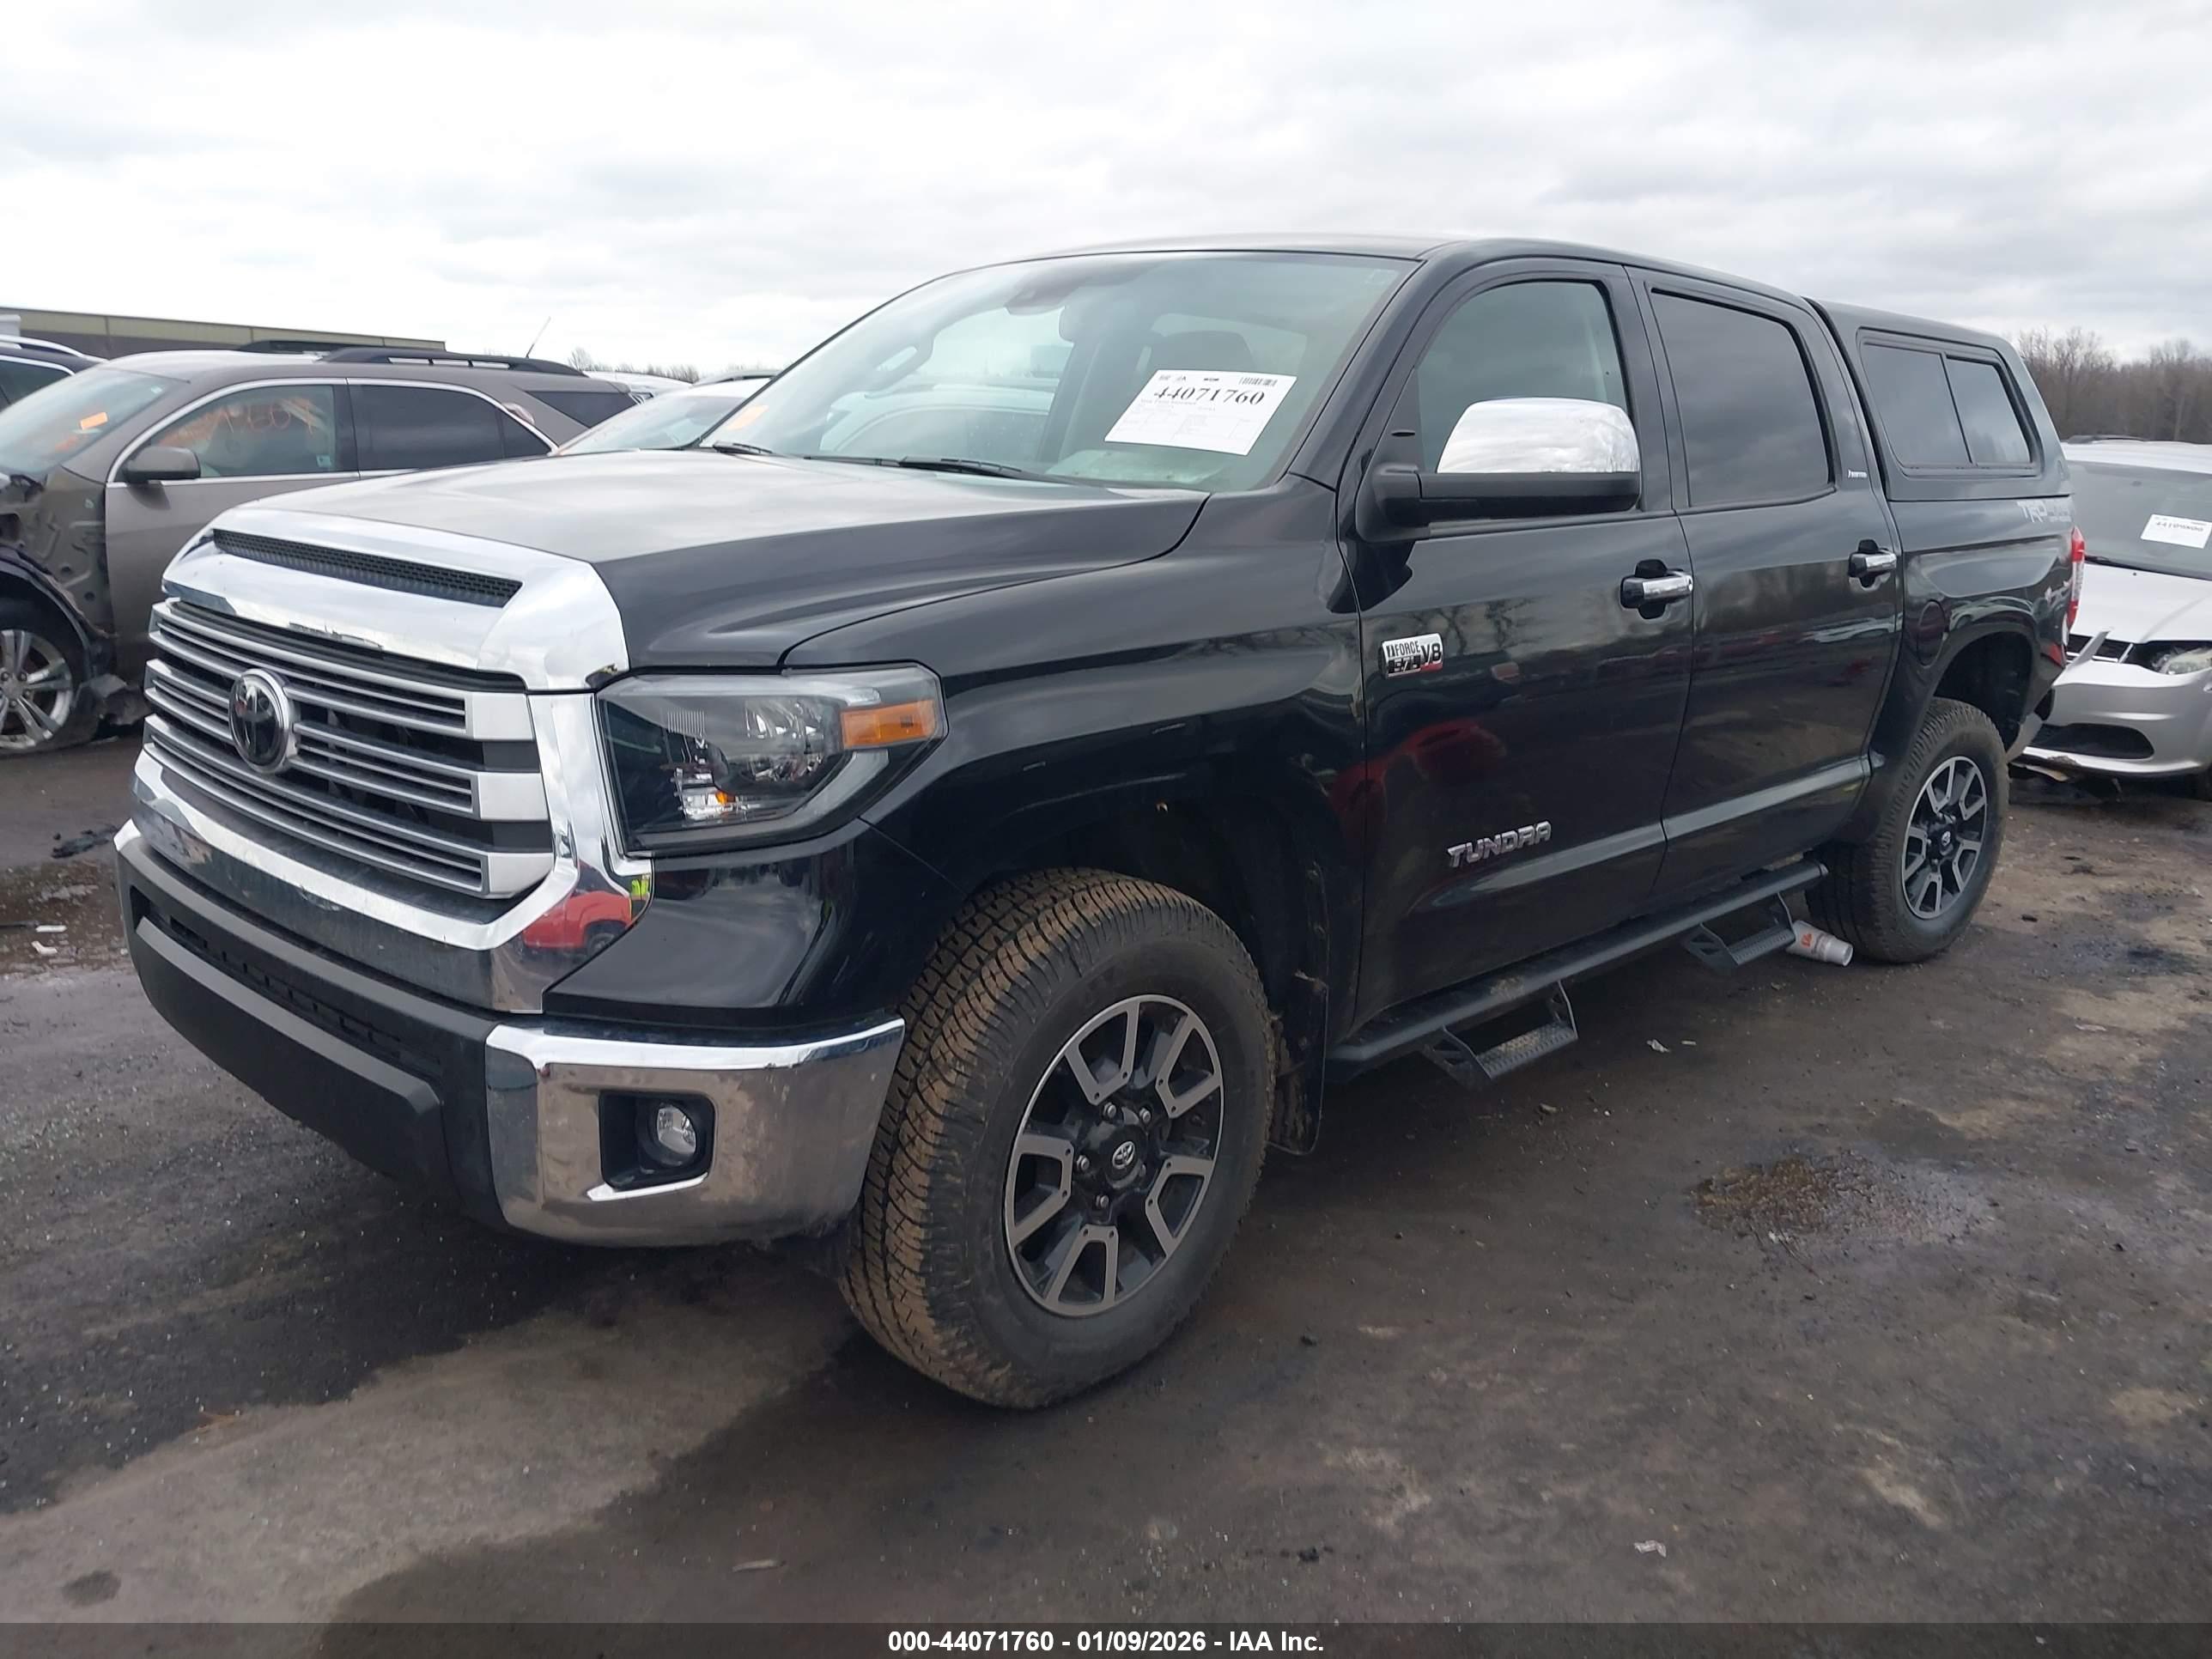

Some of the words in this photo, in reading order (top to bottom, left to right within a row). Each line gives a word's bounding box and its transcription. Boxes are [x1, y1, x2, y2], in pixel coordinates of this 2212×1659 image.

[1154, 386, 1265, 405] 44071760
[1421, 643, 1442, 663] V8
[1448, 820, 1552, 868] TUNDRA
